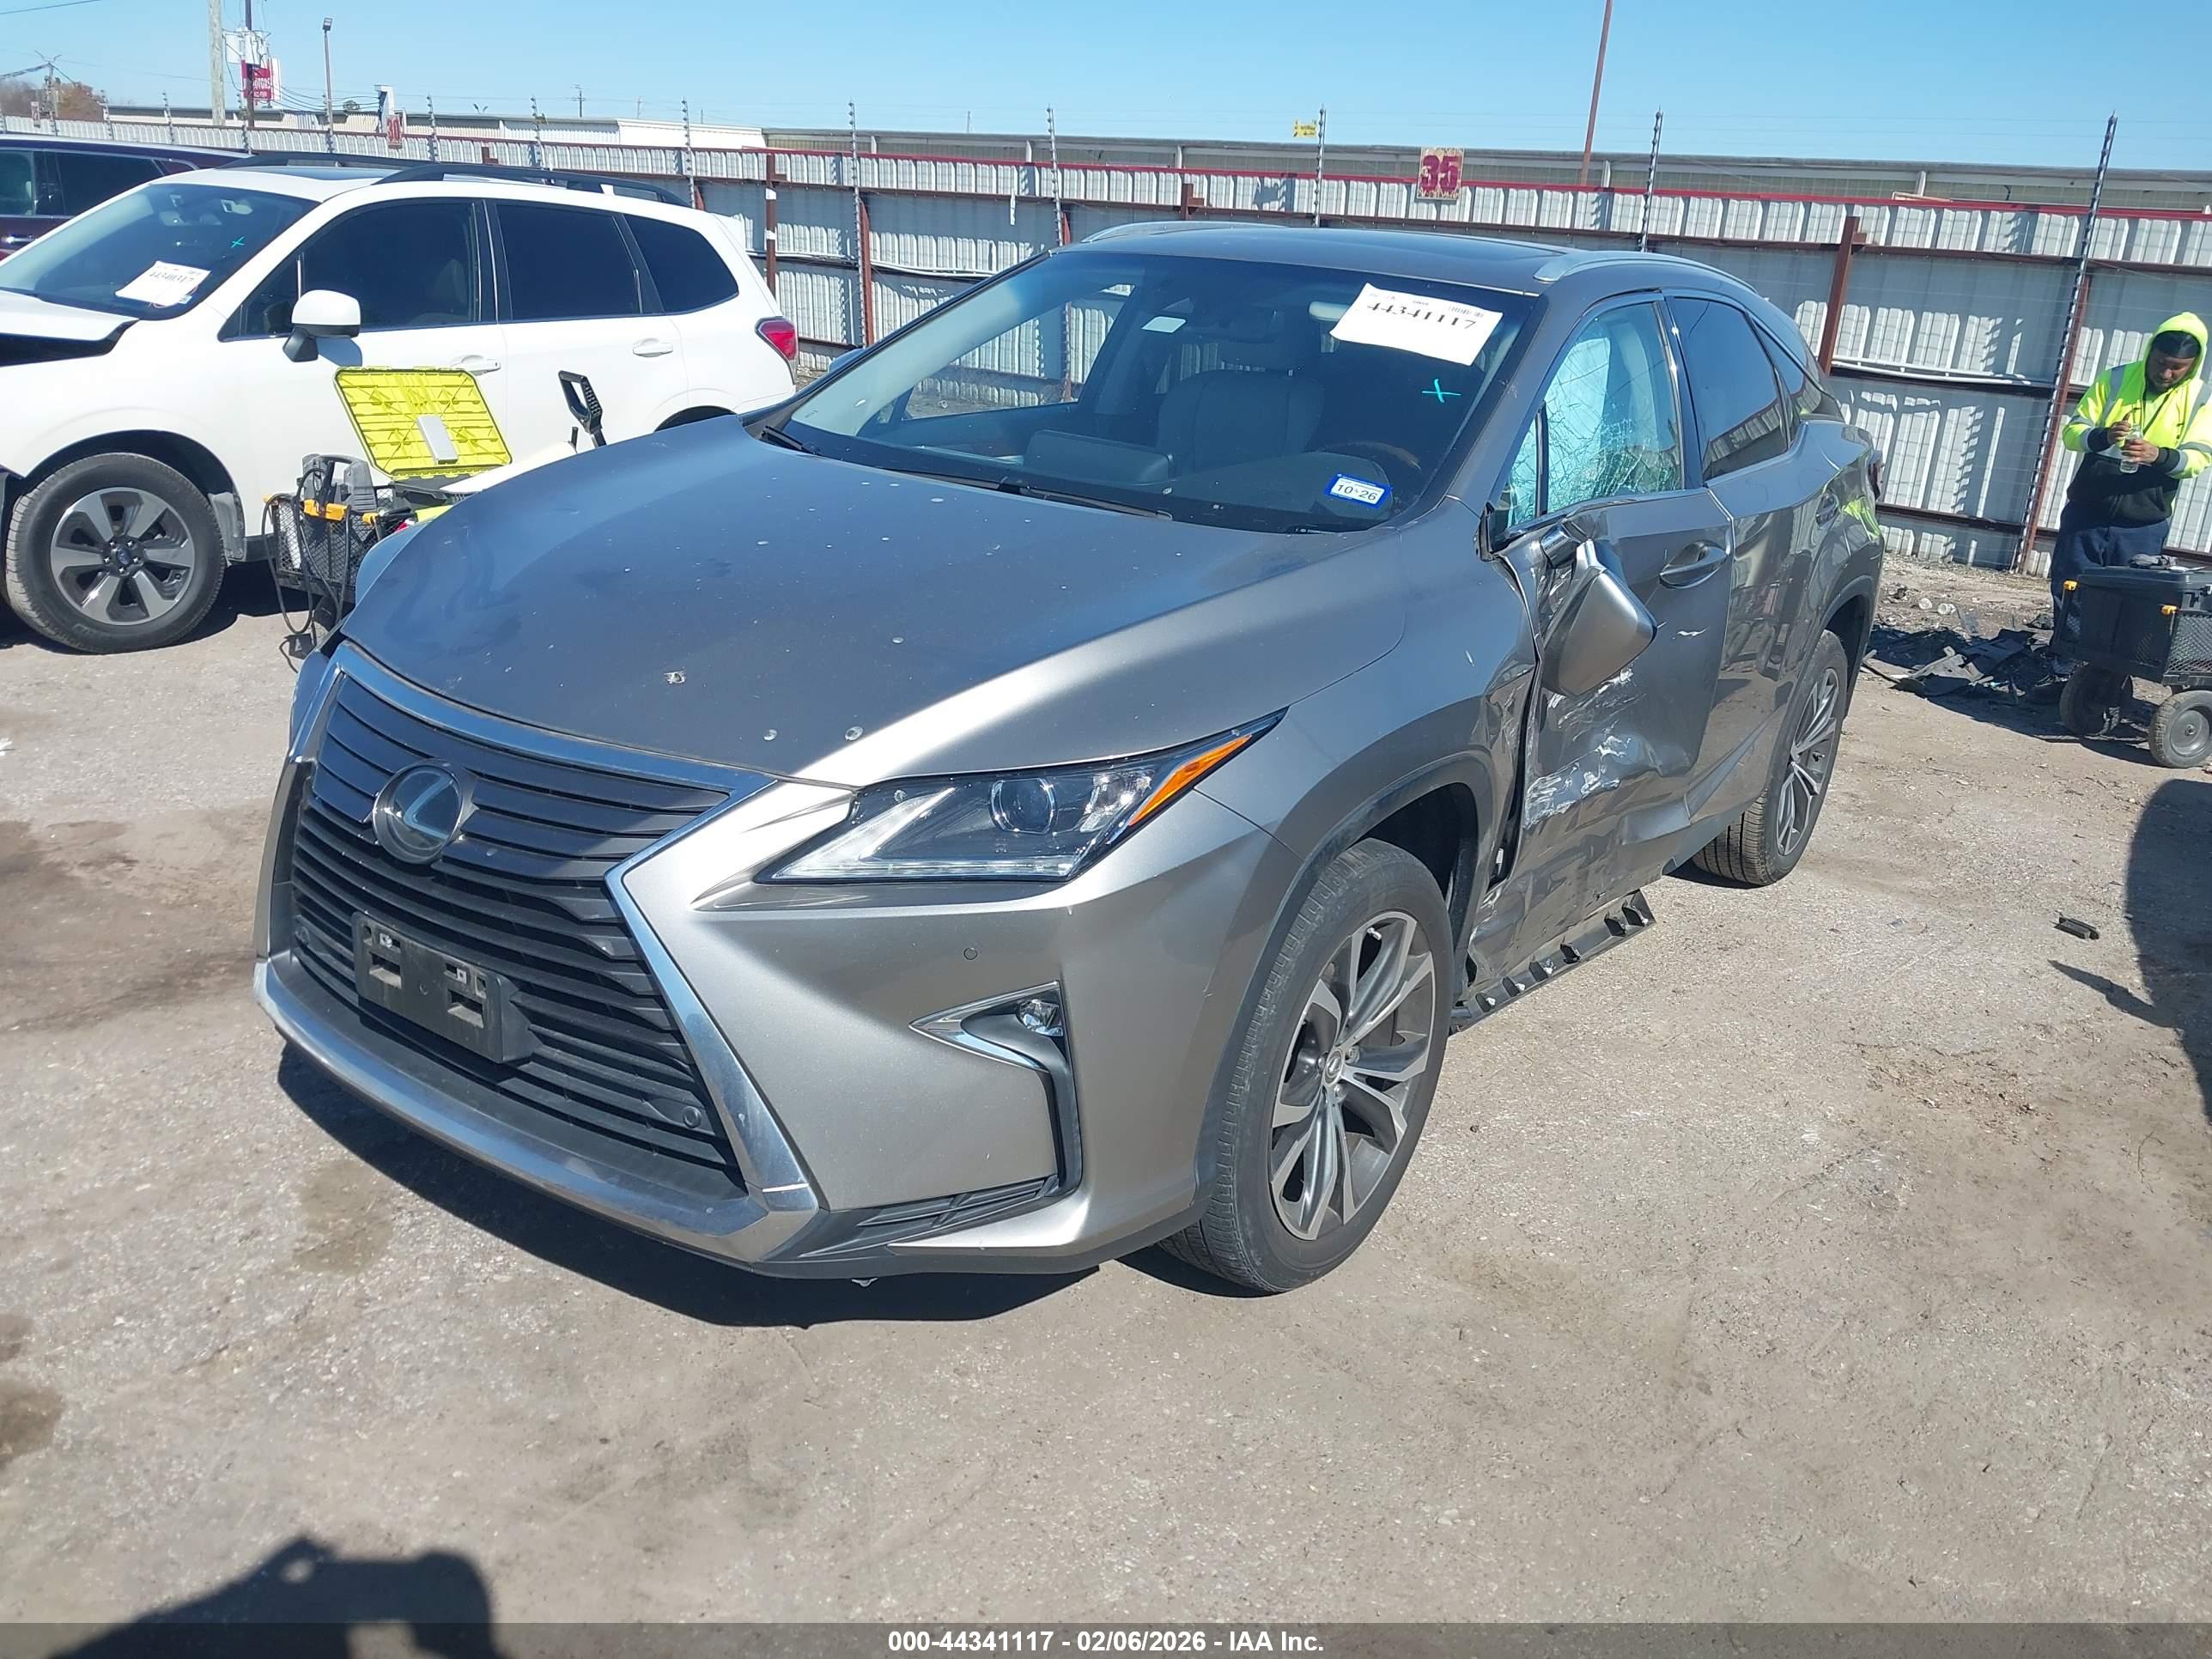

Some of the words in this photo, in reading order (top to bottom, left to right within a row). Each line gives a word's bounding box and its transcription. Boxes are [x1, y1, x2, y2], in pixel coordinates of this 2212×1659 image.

[1421, 155, 1460, 193] 35
[1367, 302, 1477, 330] 44341117
[1336, 483, 1354, 495] 10
[1358, 489, 1378, 501] 26
